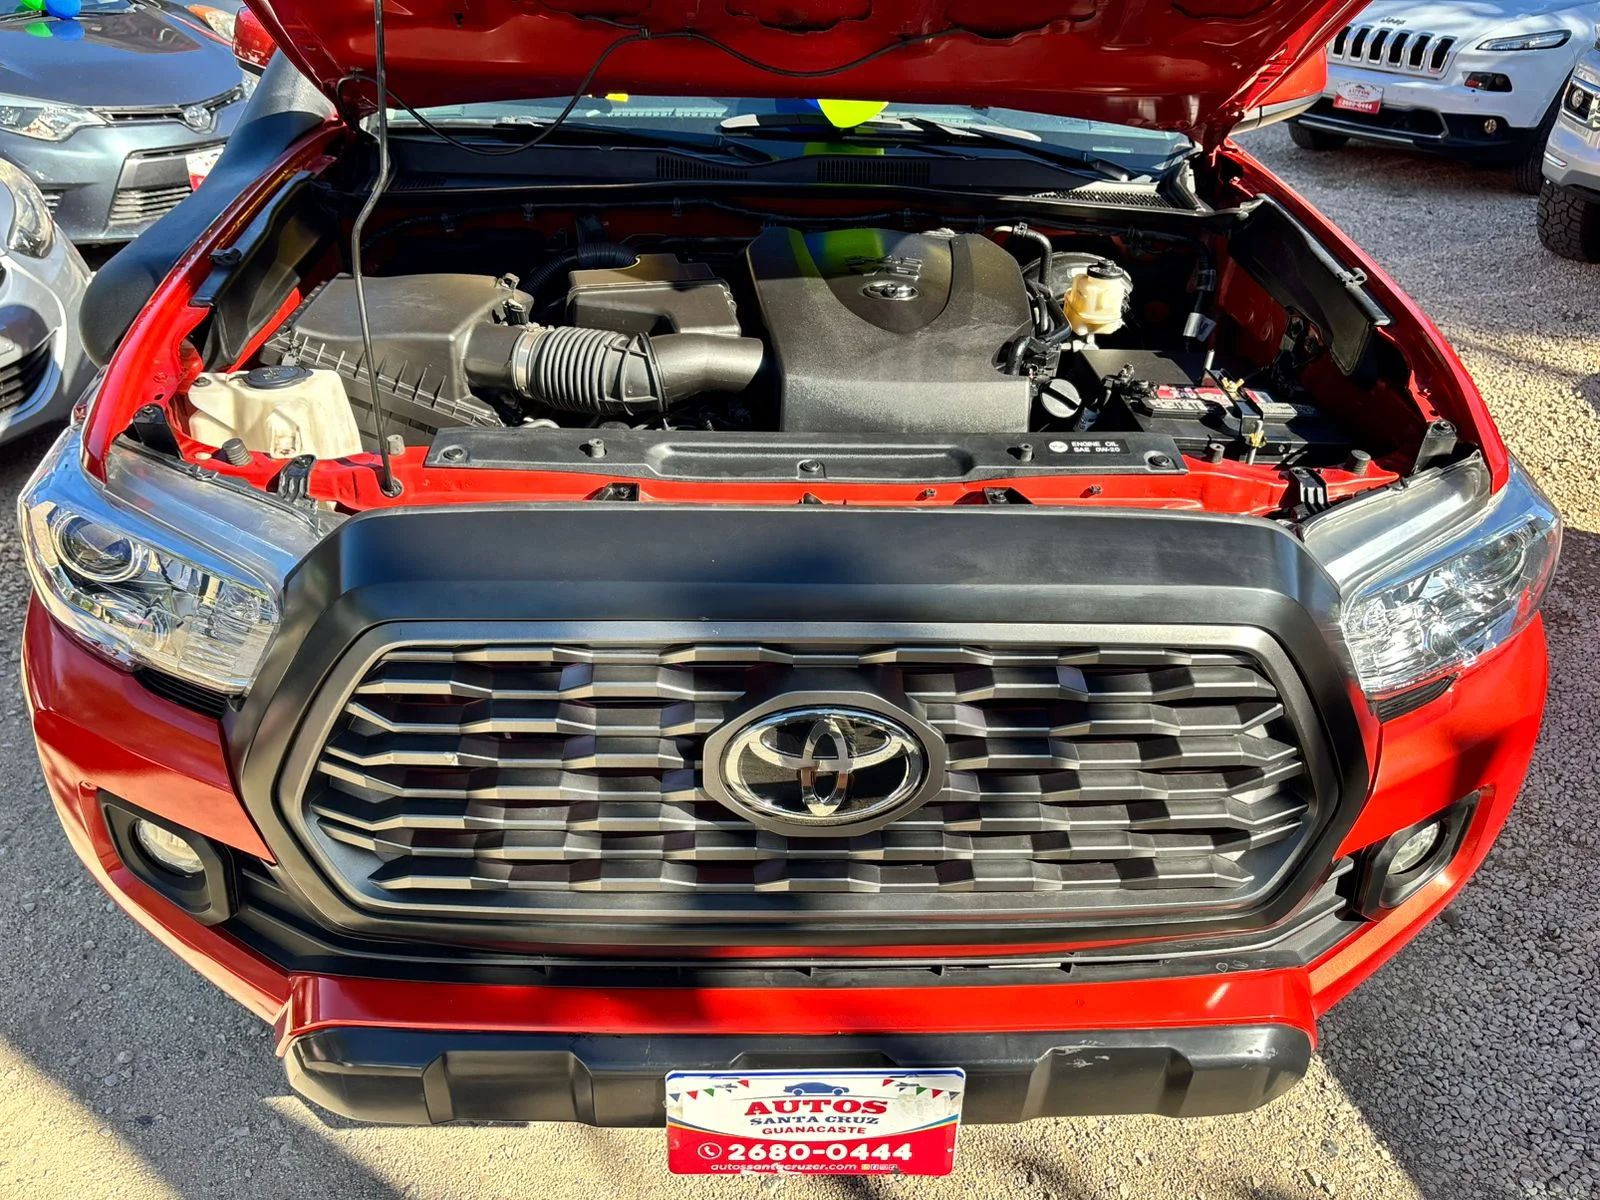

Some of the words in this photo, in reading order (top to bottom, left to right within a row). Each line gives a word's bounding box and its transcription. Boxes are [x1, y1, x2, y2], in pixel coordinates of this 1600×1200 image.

[744, 1100, 888, 1116] AUTOS
[750, 1116, 819, 1125] SANTA
[825, 1116, 879, 1124] CRUZ
[762, 1126, 866, 1135] GUANACASTE
[727, 1143, 912, 1161] 2680-0444
